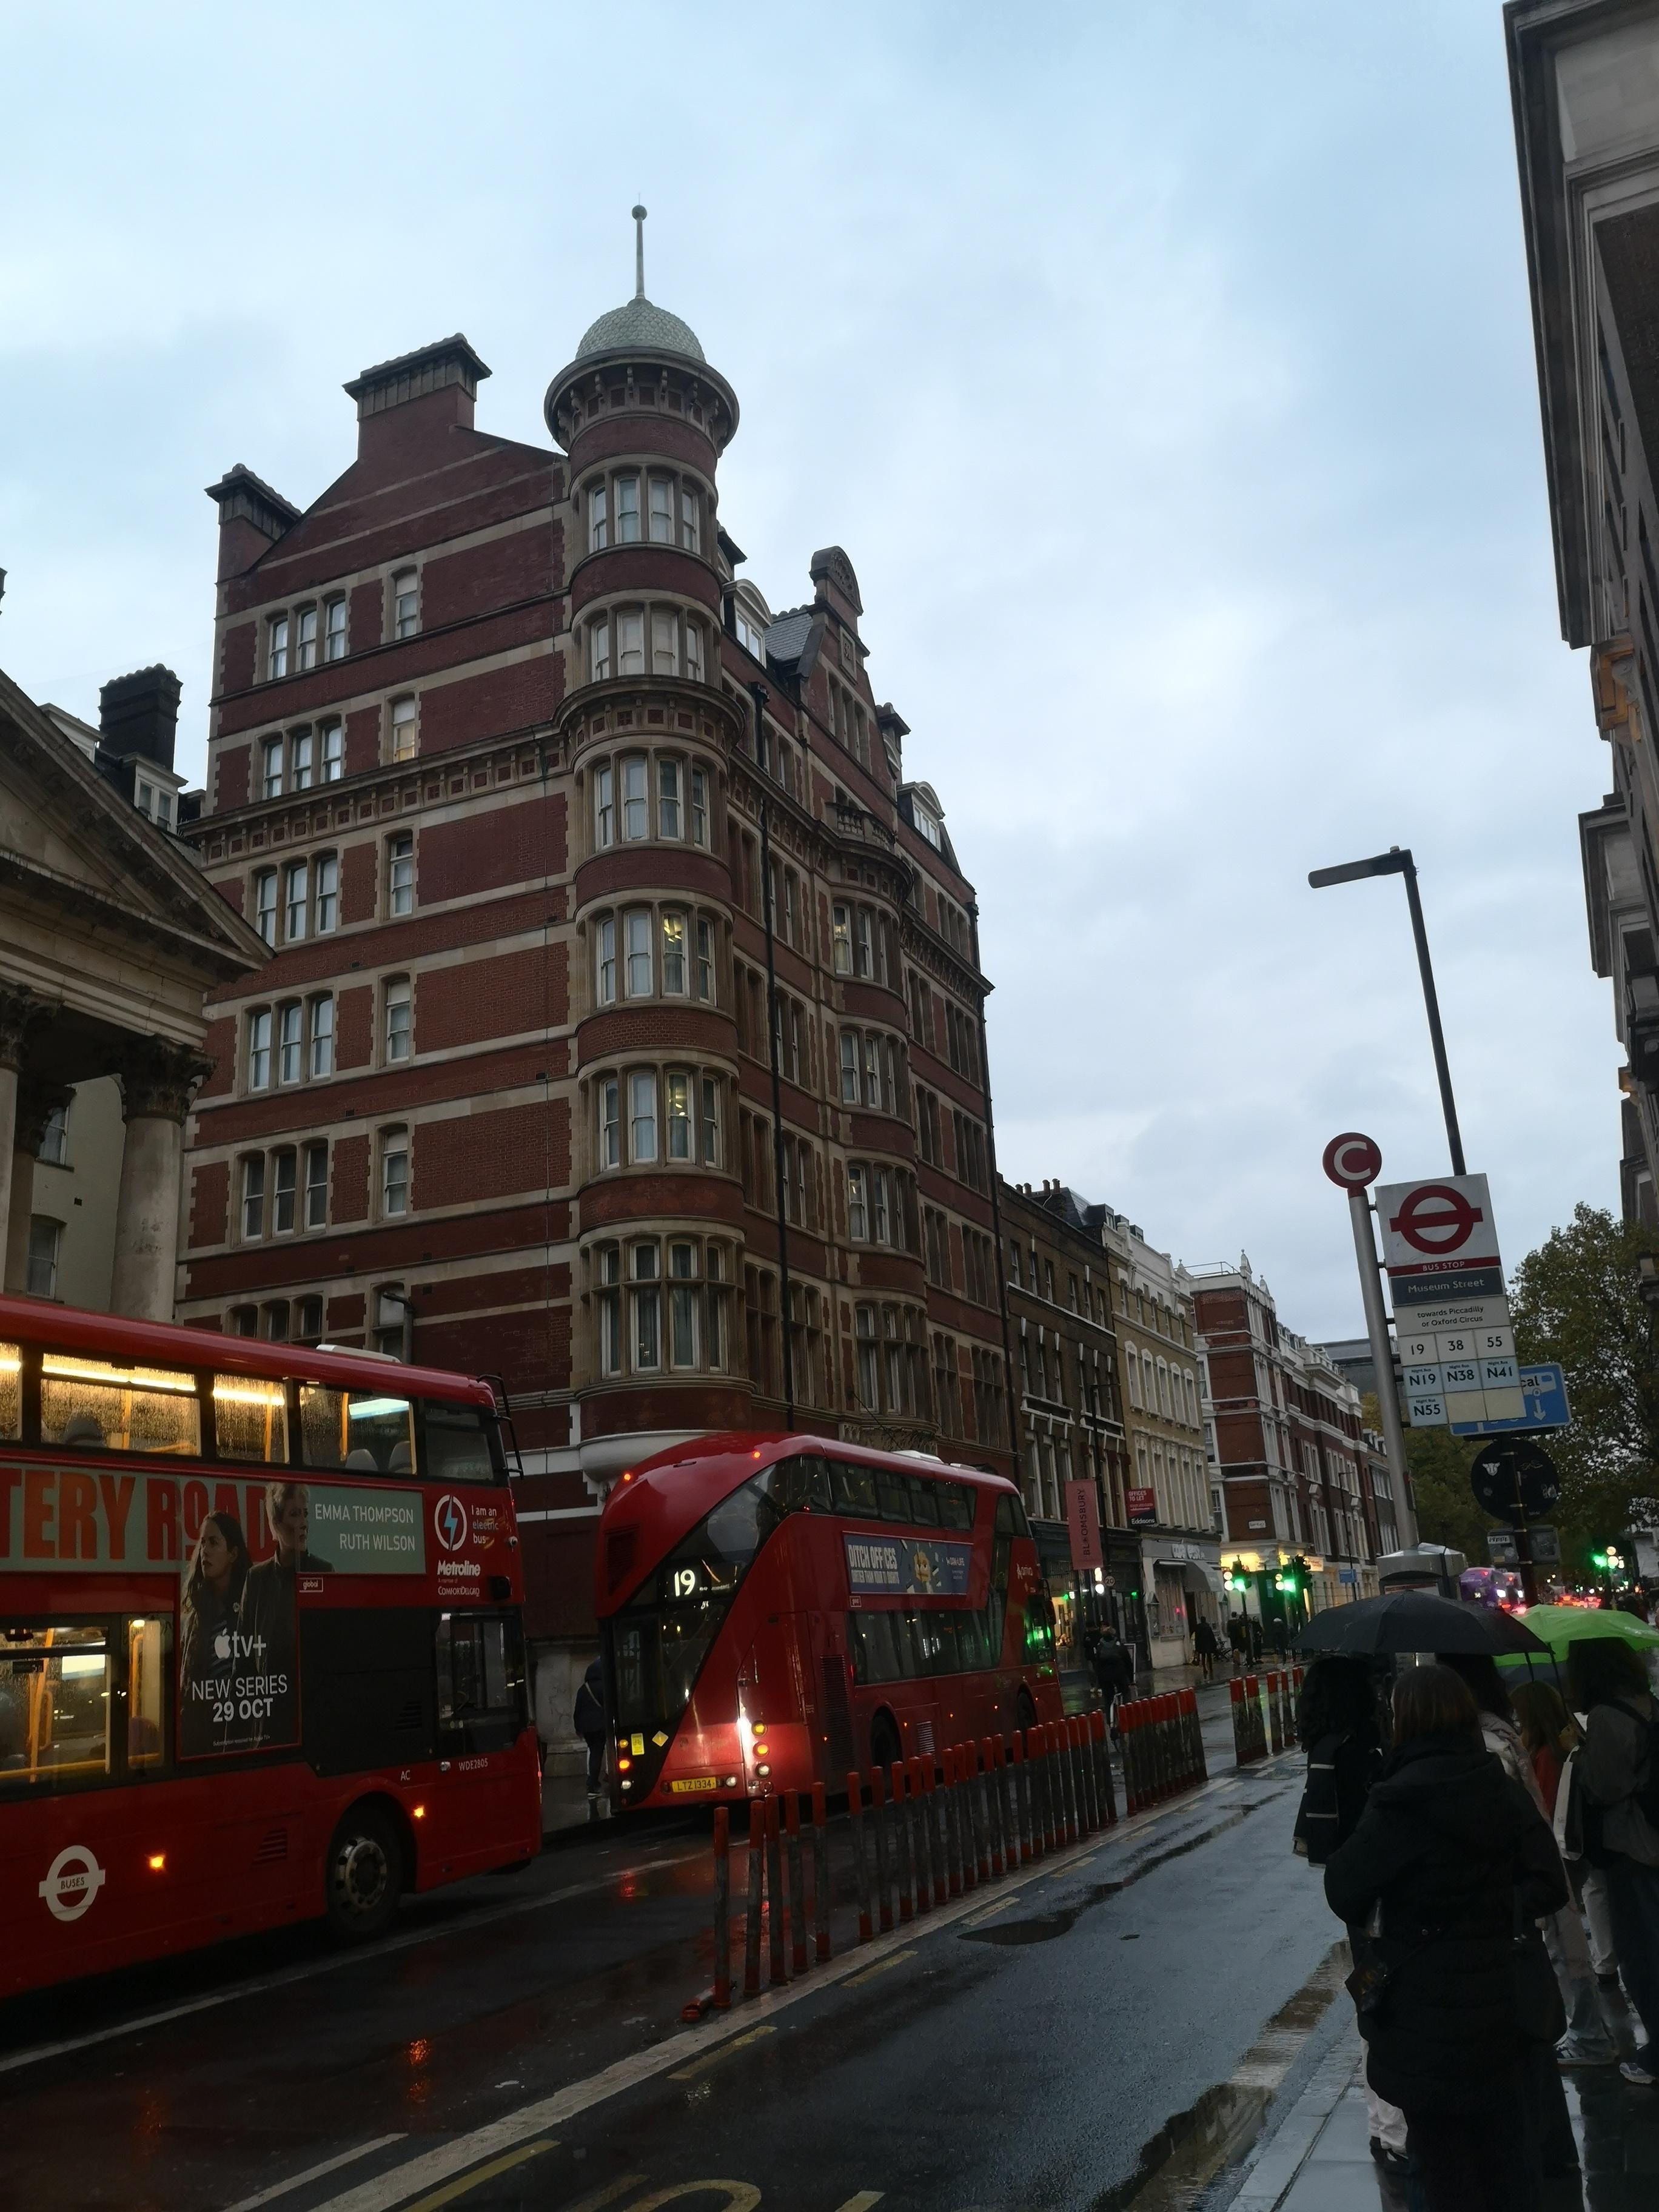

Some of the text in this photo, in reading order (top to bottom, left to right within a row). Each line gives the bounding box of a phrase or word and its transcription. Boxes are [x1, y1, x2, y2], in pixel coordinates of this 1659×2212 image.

[1333, 1141, 1371, 1181] C
[1423, 1261, 1465, 1272] BUS STOP
[1407, 1278, 1485, 1293] Museum Street
[1418, 1305, 1484, 1318] towards Piccadilly
[1448, 1340, 1464, 1351] 38
[1487, 1336, 1503, 1347] 55
[1411, 1344, 1424, 1355] 19
[1447, 1369, 1475, 1382] N38
[1487, 1366, 1513, 1378] N41
[1409, 1373, 1436, 1386] N19
[1413, 1404, 1441, 1416] N55
[315, 1503, 414, 1523] EMMA THOMPSON
[471, 1504, 474, 1515] I
[488, 1507, 497, 1516] an
[472, 1519, 499, 1530] electric
[340, 1533, 415, 1551] RUTH WILSON
[473, 1533, 486, 1544] bus
[848, 1544, 871, 1568] DITCH
[437, 1560, 481, 1577] Metroline
[303, 1580, 318, 1590] global
[674, 1569, 695, 1597] 19
[192, 1674, 288, 1701] NEW SERIES
[213, 1697, 273, 1722] 29 OCT
[458, 1758, 488, 1771] WDE2805
[401, 1769, 411, 1781] AC
[61, 1877, 84, 1889] BUSES
